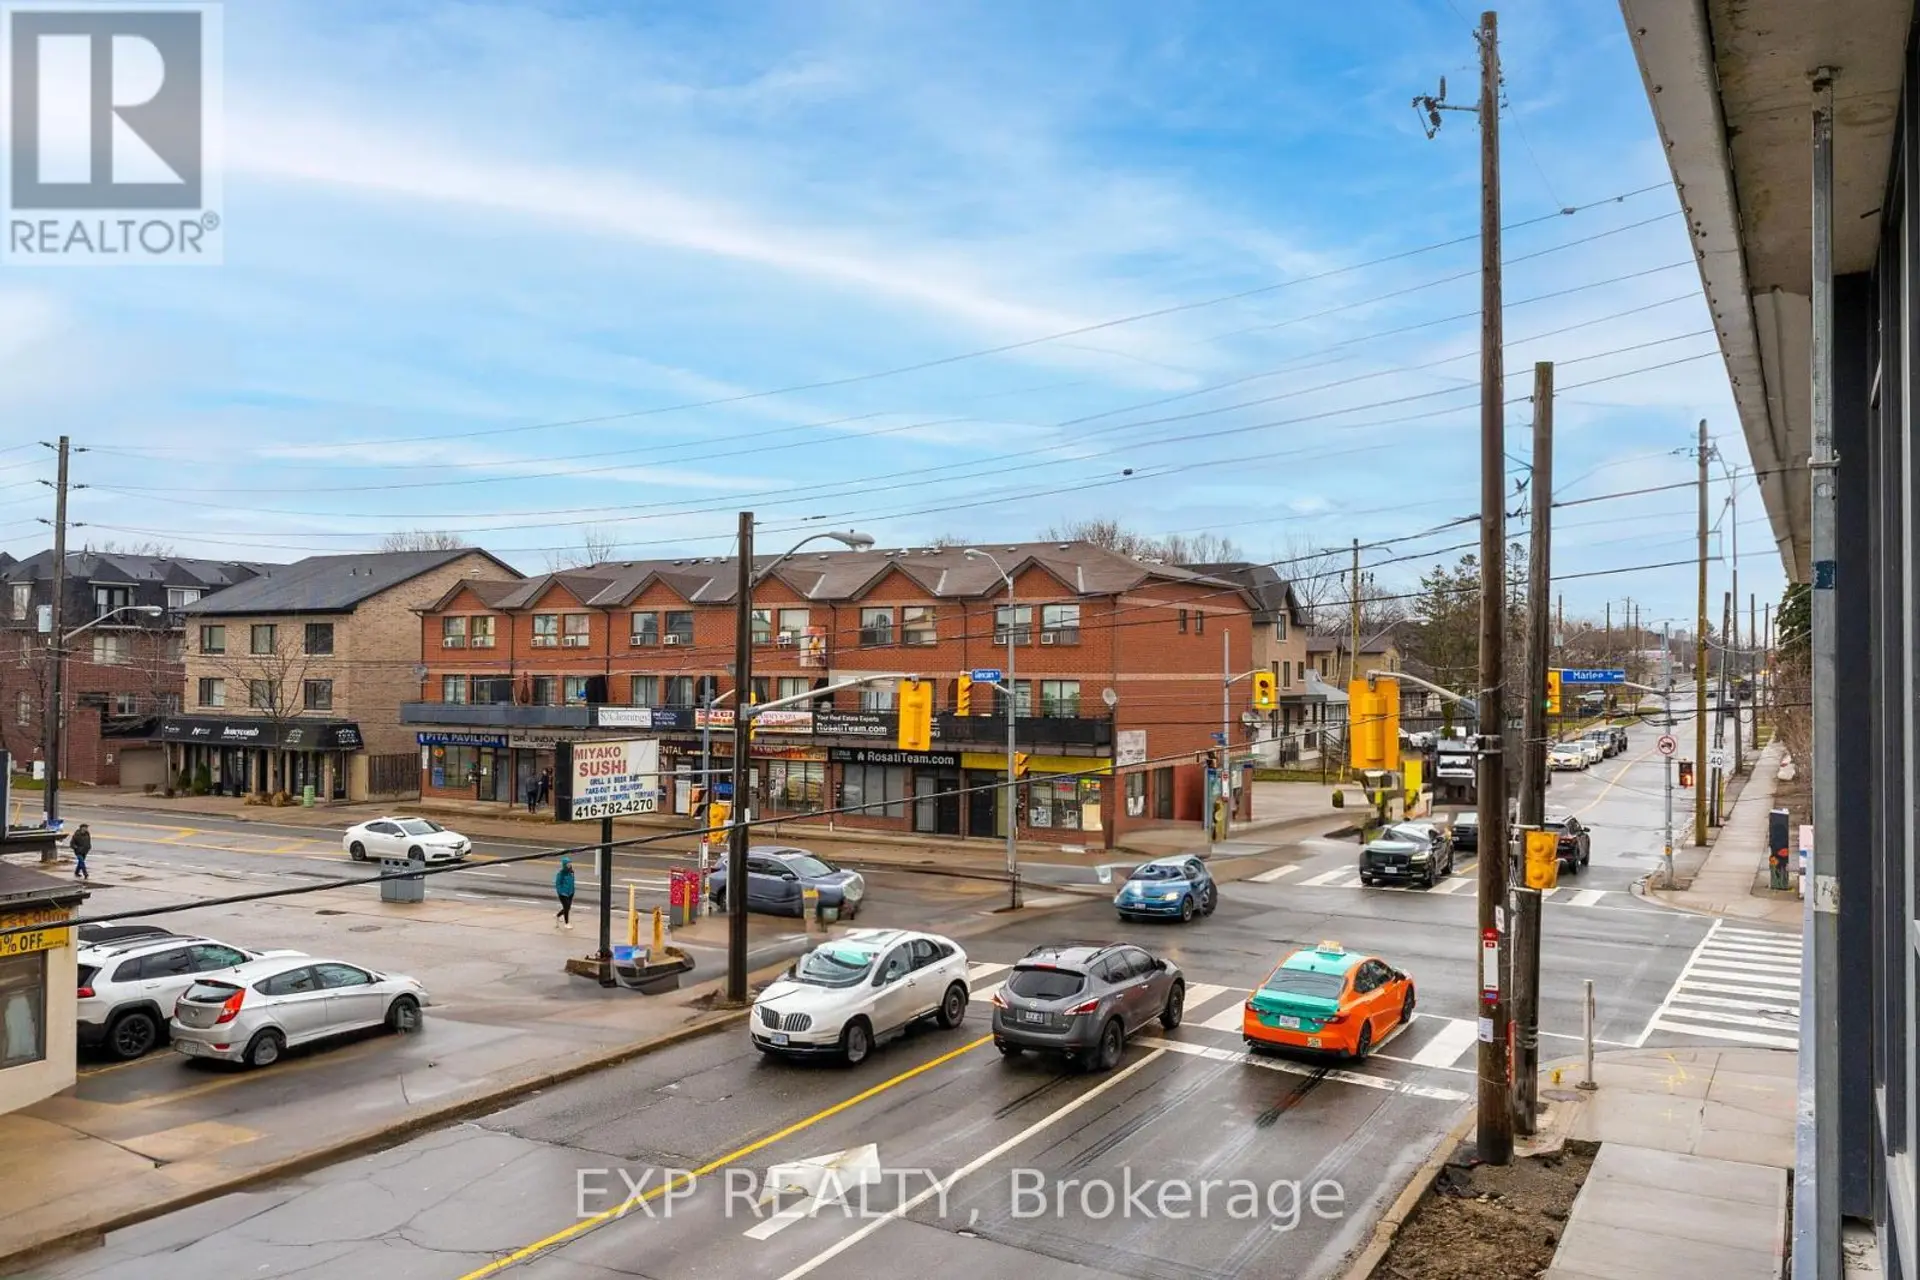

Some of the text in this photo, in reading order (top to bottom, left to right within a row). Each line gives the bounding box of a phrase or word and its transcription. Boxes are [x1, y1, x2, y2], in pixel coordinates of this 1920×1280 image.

[1572, 670, 1604, 680] Marlee
[426, 732, 498, 744] PITA PAVILION
[574, 746, 621, 760] MIYAKO
[659, 745, 683, 755] ENTAL
[867, 751, 954, 765] RosatiTeam.com
[1711, 756, 1722, 766] 40
[579, 760, 627, 777] SUSHI
[620, 783, 643, 792] DELIVERY
[575, 799, 653, 818] 416-782-4270
[20, 932, 43, 951] OFF
